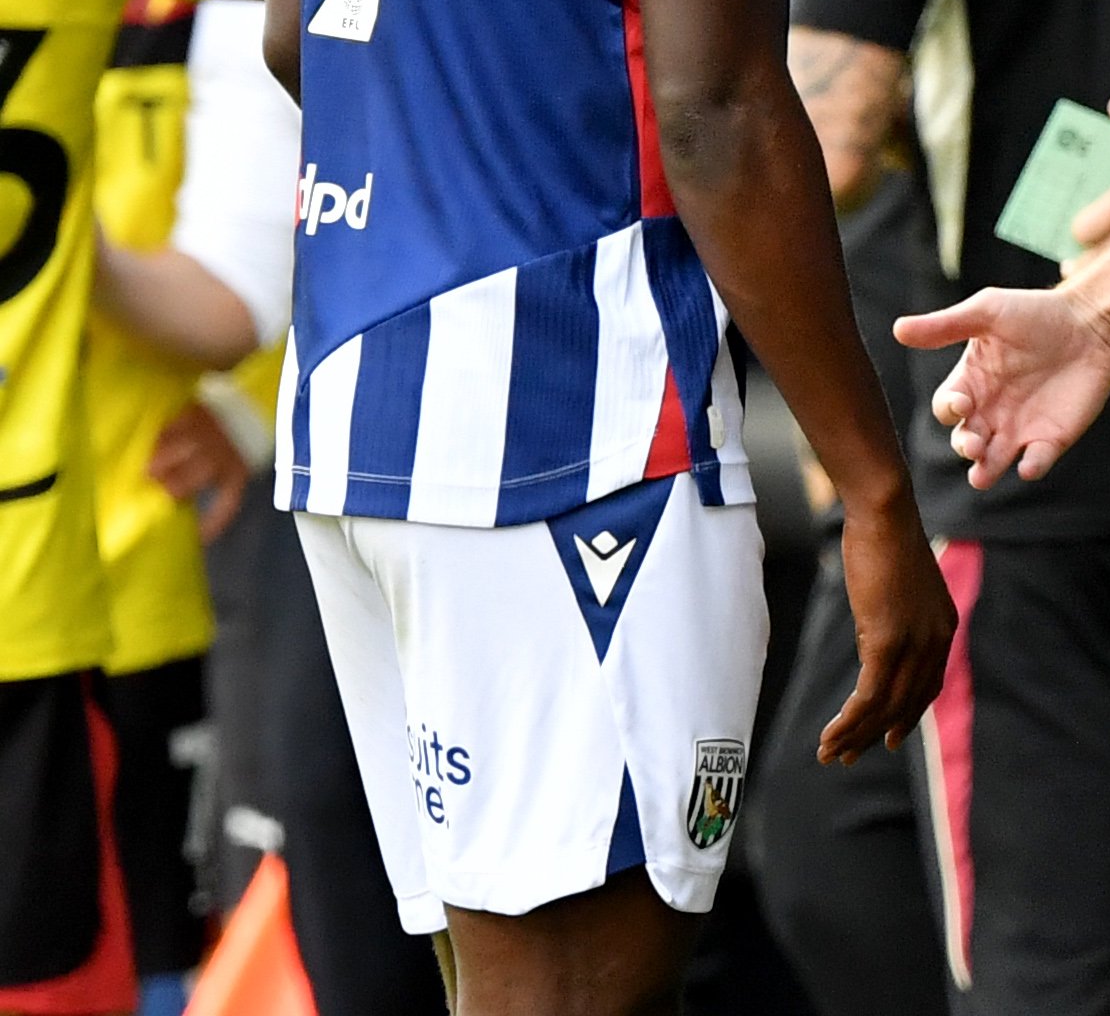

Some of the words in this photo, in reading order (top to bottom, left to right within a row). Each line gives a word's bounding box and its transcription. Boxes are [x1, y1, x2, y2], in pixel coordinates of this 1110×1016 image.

[342, 17, 360, 31] EFL
[299, 163, 373, 236] dpd
[699, 755, 743, 774] ALBION
